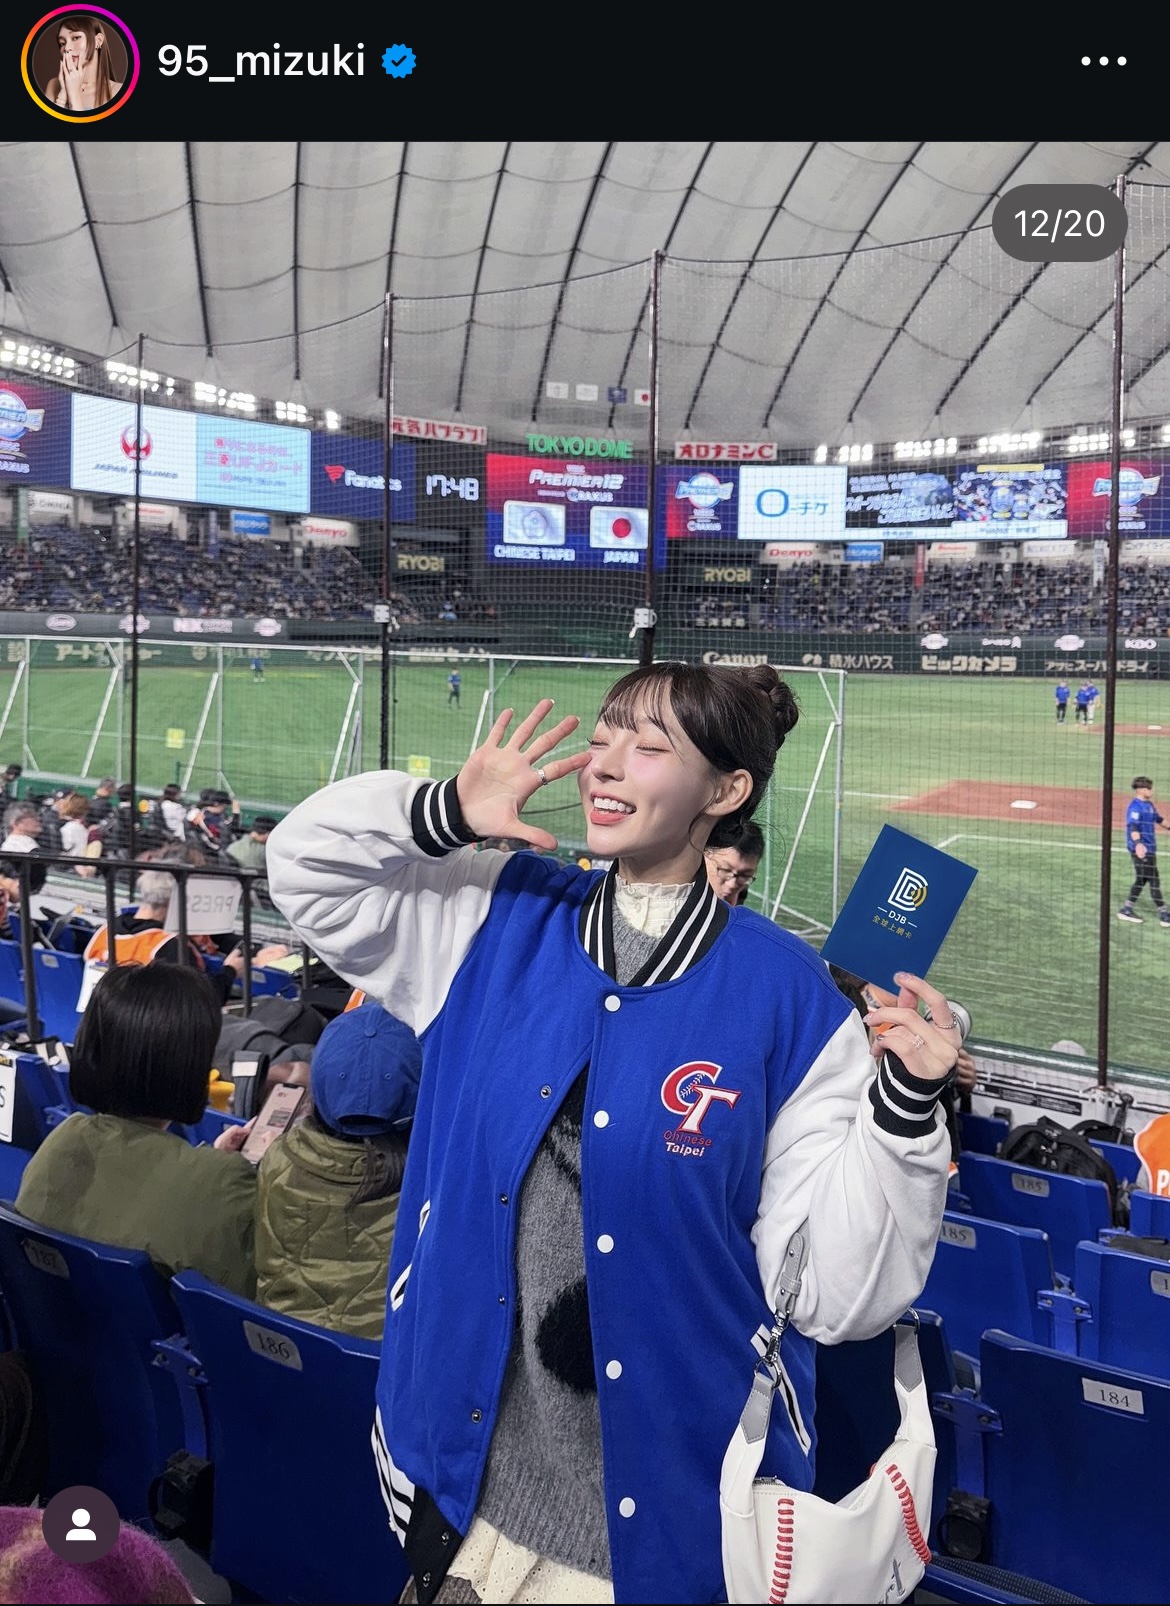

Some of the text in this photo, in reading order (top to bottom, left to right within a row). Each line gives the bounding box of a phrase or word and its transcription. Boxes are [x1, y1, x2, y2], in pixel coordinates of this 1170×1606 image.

[526, 433, 634, 459] TOKYO DOME
[344, 469, 402, 492] Fanatcs
[426, 474, 479, 501] 17:48
[397, 554, 445, 572] RYOBI
[704, 567, 752, 583] RYOBI
[702, 651, 769, 665] Canon
[921, 655, 1018, 672] ビックカメラ
[888, 910, 907, 925] DJB
[666, 1141, 706, 1157] Taipei
[941, 1226, 967, 1242] 185
[257, 1332, 290, 1360] 186
[1100, 1389, 1129, 1408] 184
